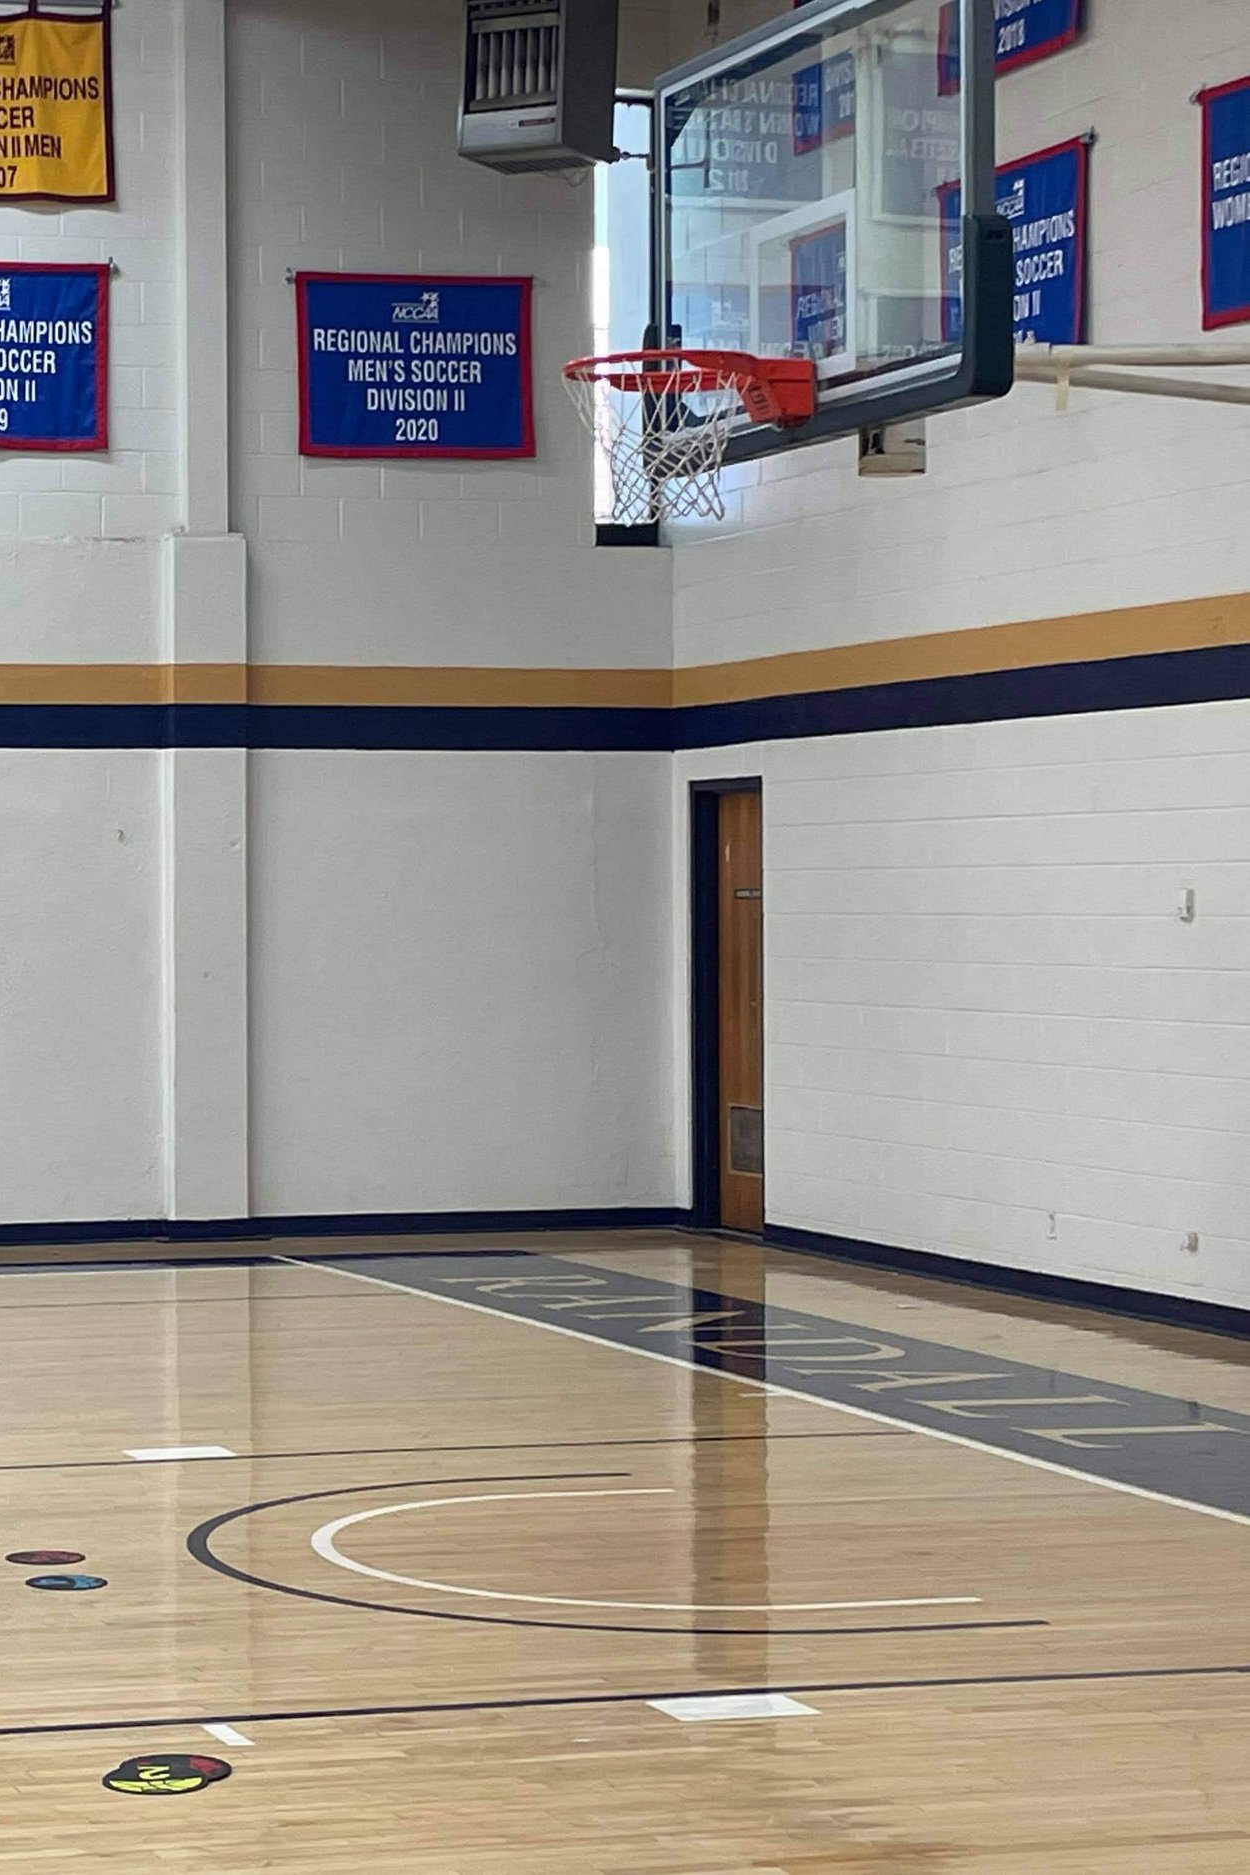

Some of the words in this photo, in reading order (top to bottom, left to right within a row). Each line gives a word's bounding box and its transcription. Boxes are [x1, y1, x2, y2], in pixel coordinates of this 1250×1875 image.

[11, 136, 21, 159] II
[25, 135, 62, 159] MEN
[1212, 191, 1250, 230] WOM
[1013, 209, 1075, 253] HAMPIONS
[1015, 250, 1063, 287] SOCCER
[313, 328, 405, 354] REGIONAL
[410, 330, 517, 356] CHAMPIONS
[348, 359, 405, 383] MEN'S
[411, 360, 482, 384] SOCCER
[25, 379, 36, 402] II
[366, 388, 448, 412] DIVISION
[454, 389, 465, 412] II
[395, 418, 439, 441] 2020
[440, 1274, 1250, 1449] RANDALL
